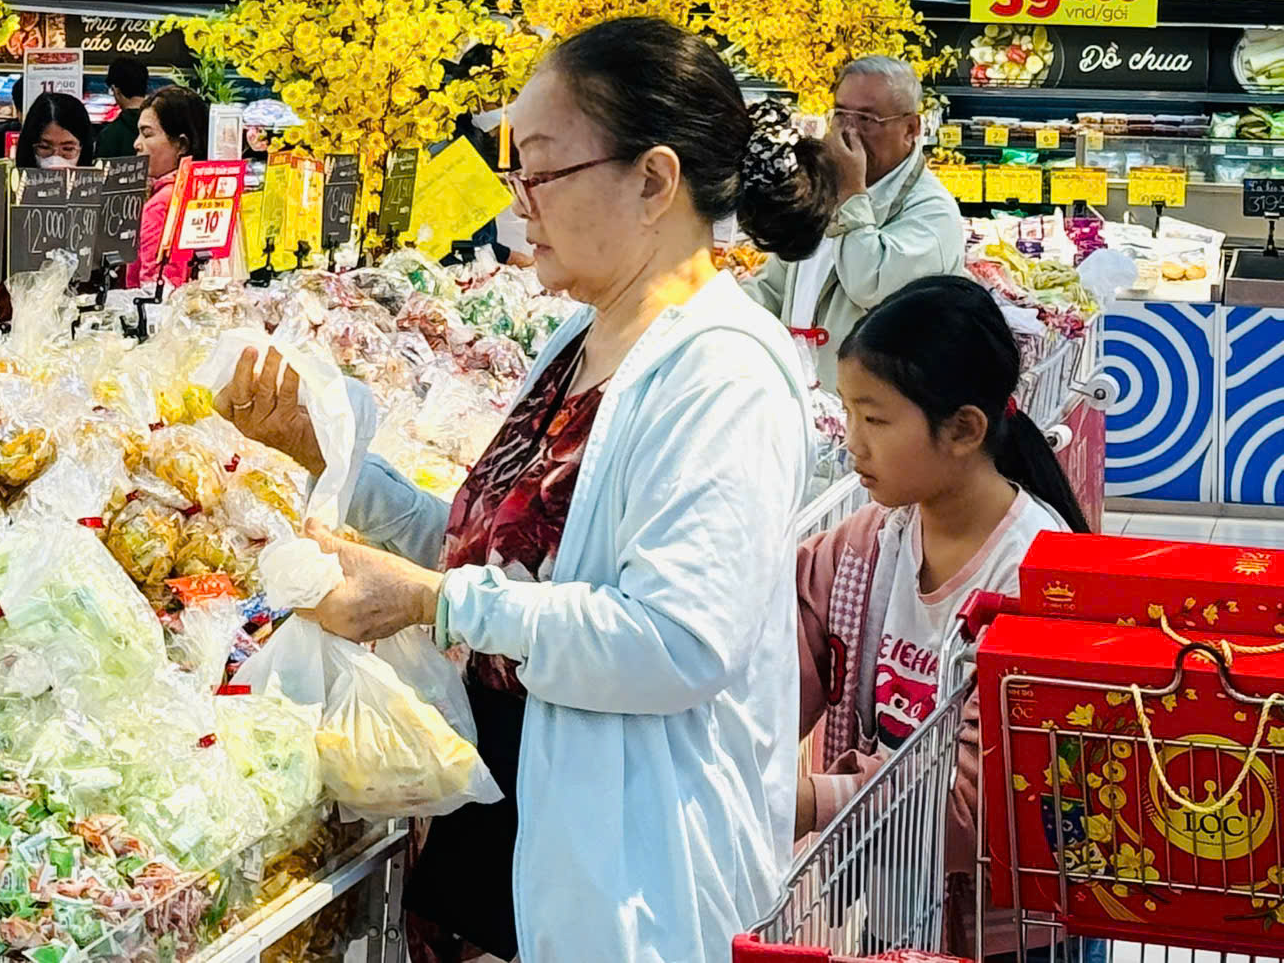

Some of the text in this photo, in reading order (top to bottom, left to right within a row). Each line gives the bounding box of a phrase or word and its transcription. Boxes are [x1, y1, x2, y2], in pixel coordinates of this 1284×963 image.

[1066, 4, 1129, 22] vnd/gói
[81, 33, 156, 55] các loại
[1079, 41, 1193, 72] Đồ chua
